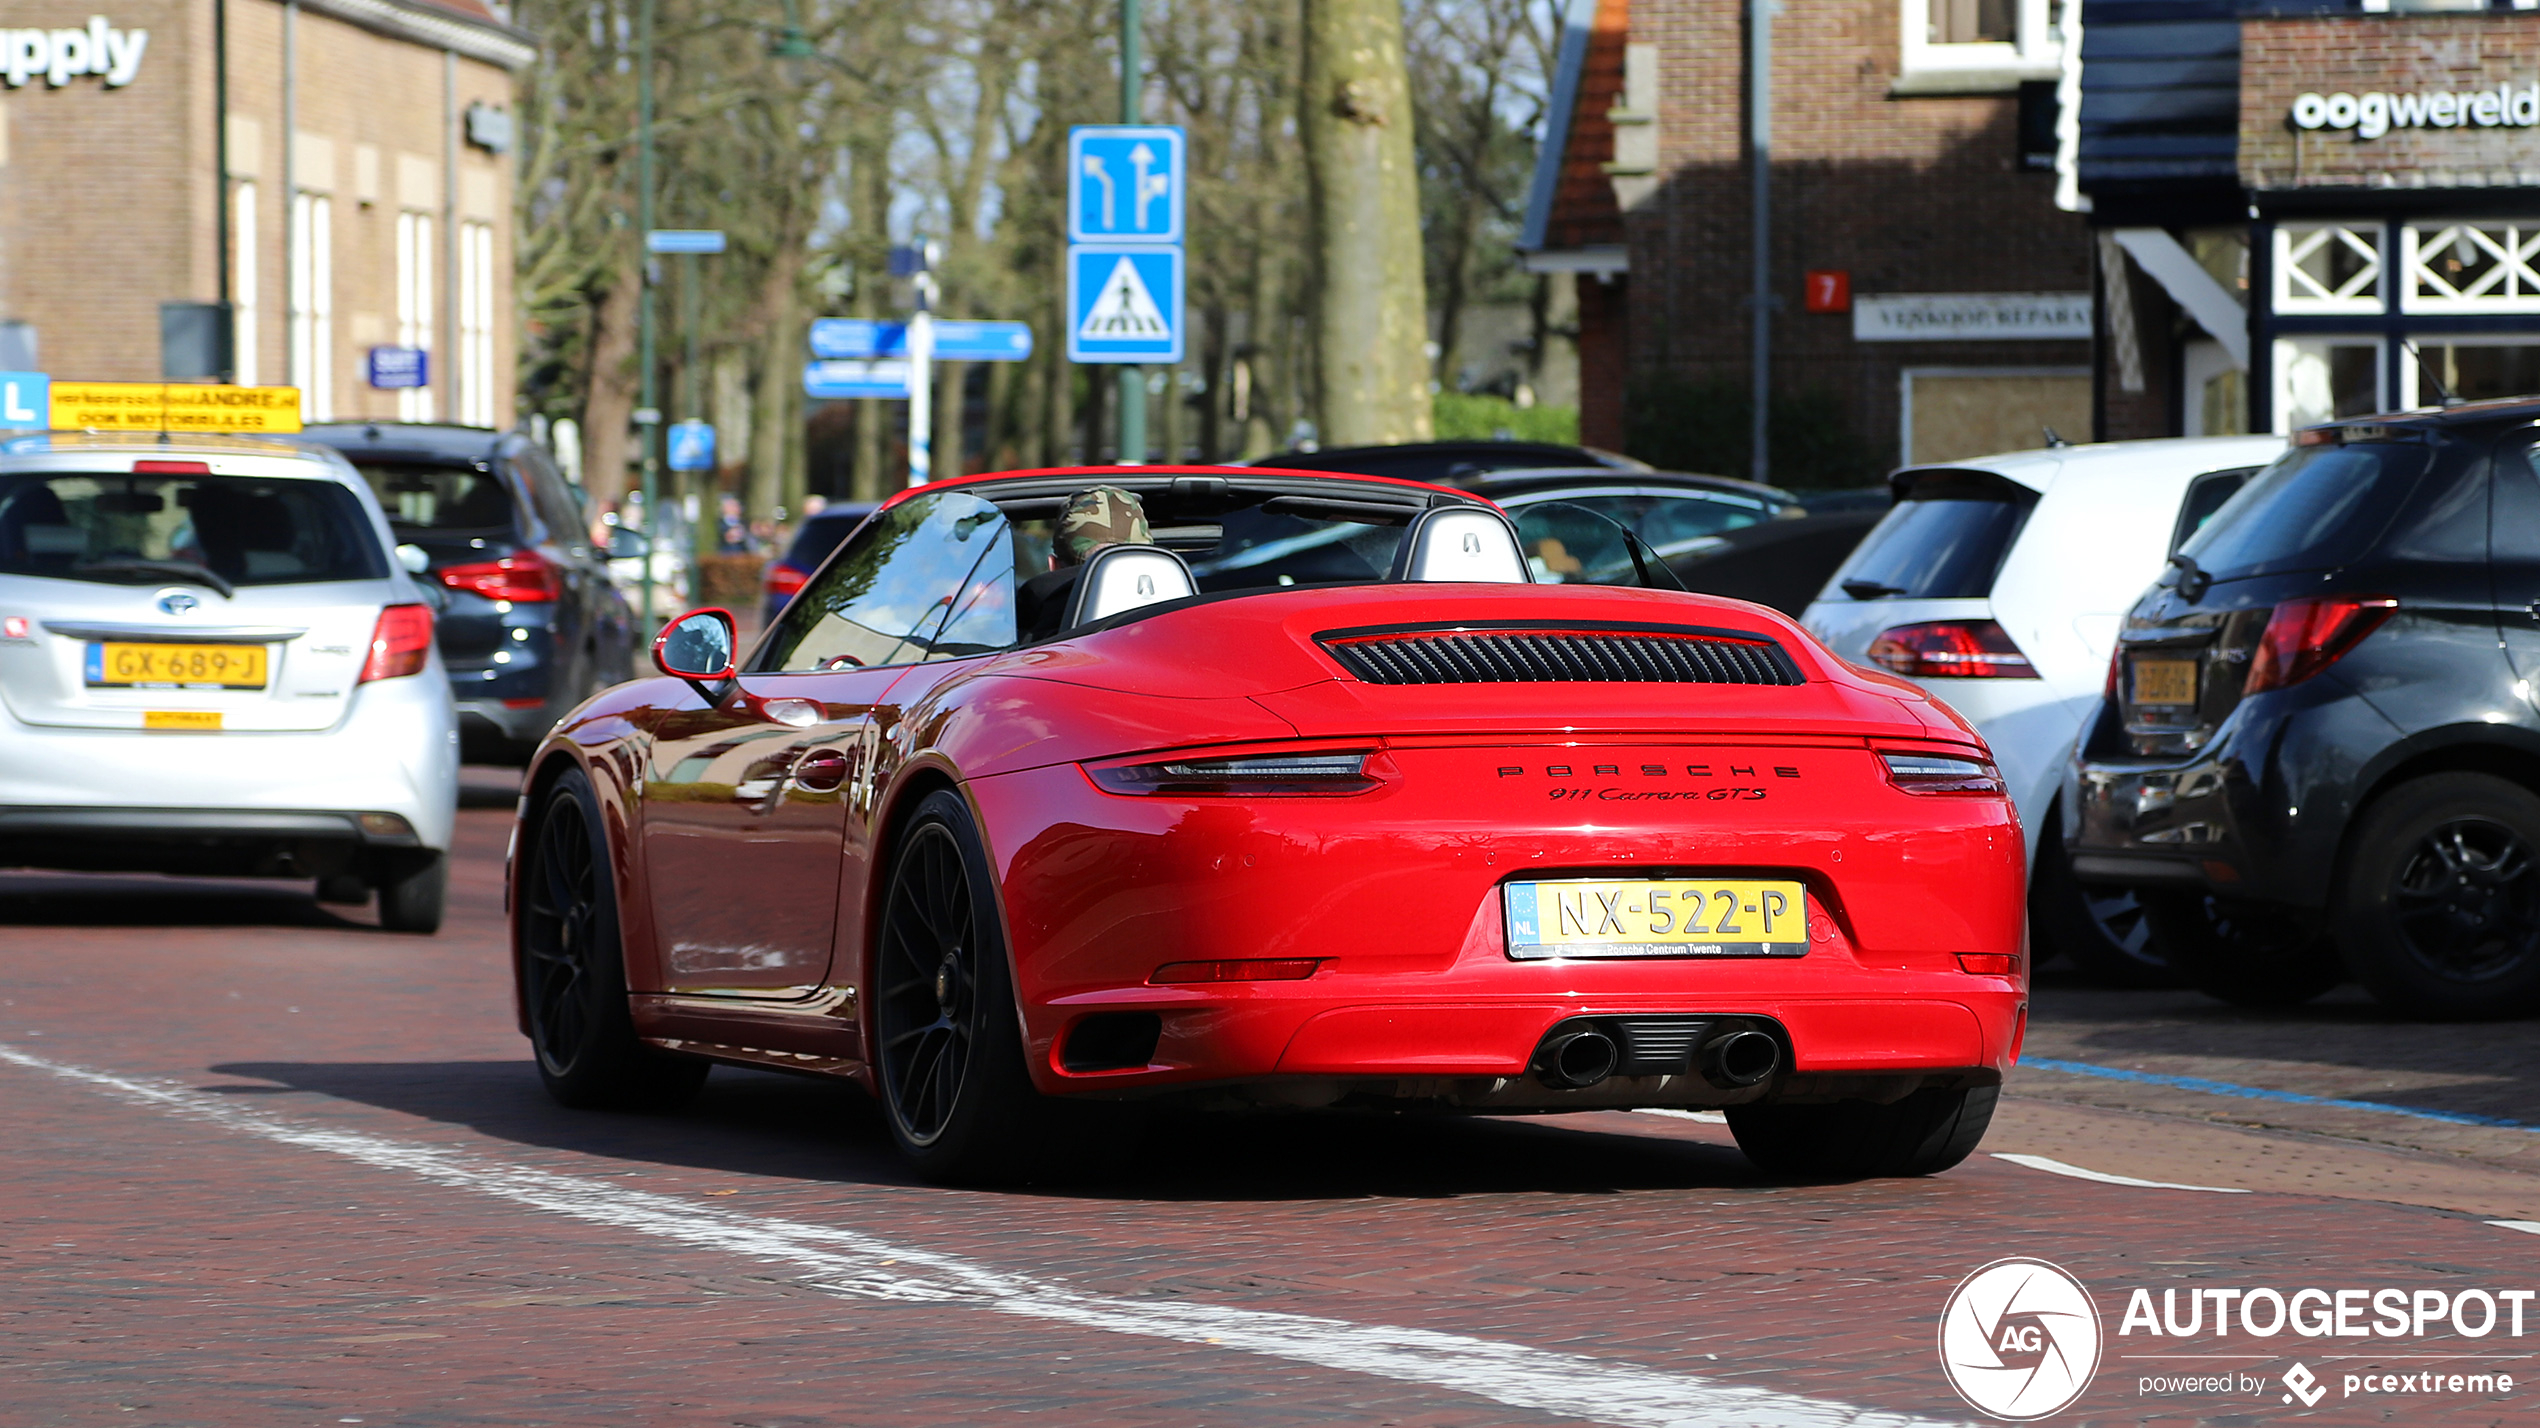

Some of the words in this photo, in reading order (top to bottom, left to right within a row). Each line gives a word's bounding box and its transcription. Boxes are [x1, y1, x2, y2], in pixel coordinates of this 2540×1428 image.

[0, 14, 148, 86] pply
[2293, 81, 2540, 139] oogwereld
[1819, 274, 1837, 306] 7
[5, 381, 36, 421] L
[77, 412, 119, 425] OOK
[115, 650, 255, 678] GX-689-J
[1497, 765, 1800, 778] PORSCHE
[1549, 788, 1592, 800] 911
[1597, 788, 1700, 800] Carrera
[1707, 788, 1767, 800] GTS
[1558, 889, 1788, 935] NX-522-P
[1515, 920, 1537, 936] NL
[1606, 943, 1645, 956] Porsche
[1646, 943, 1686, 956] Centrum
[1688, 943, 1722, 955] Twente
